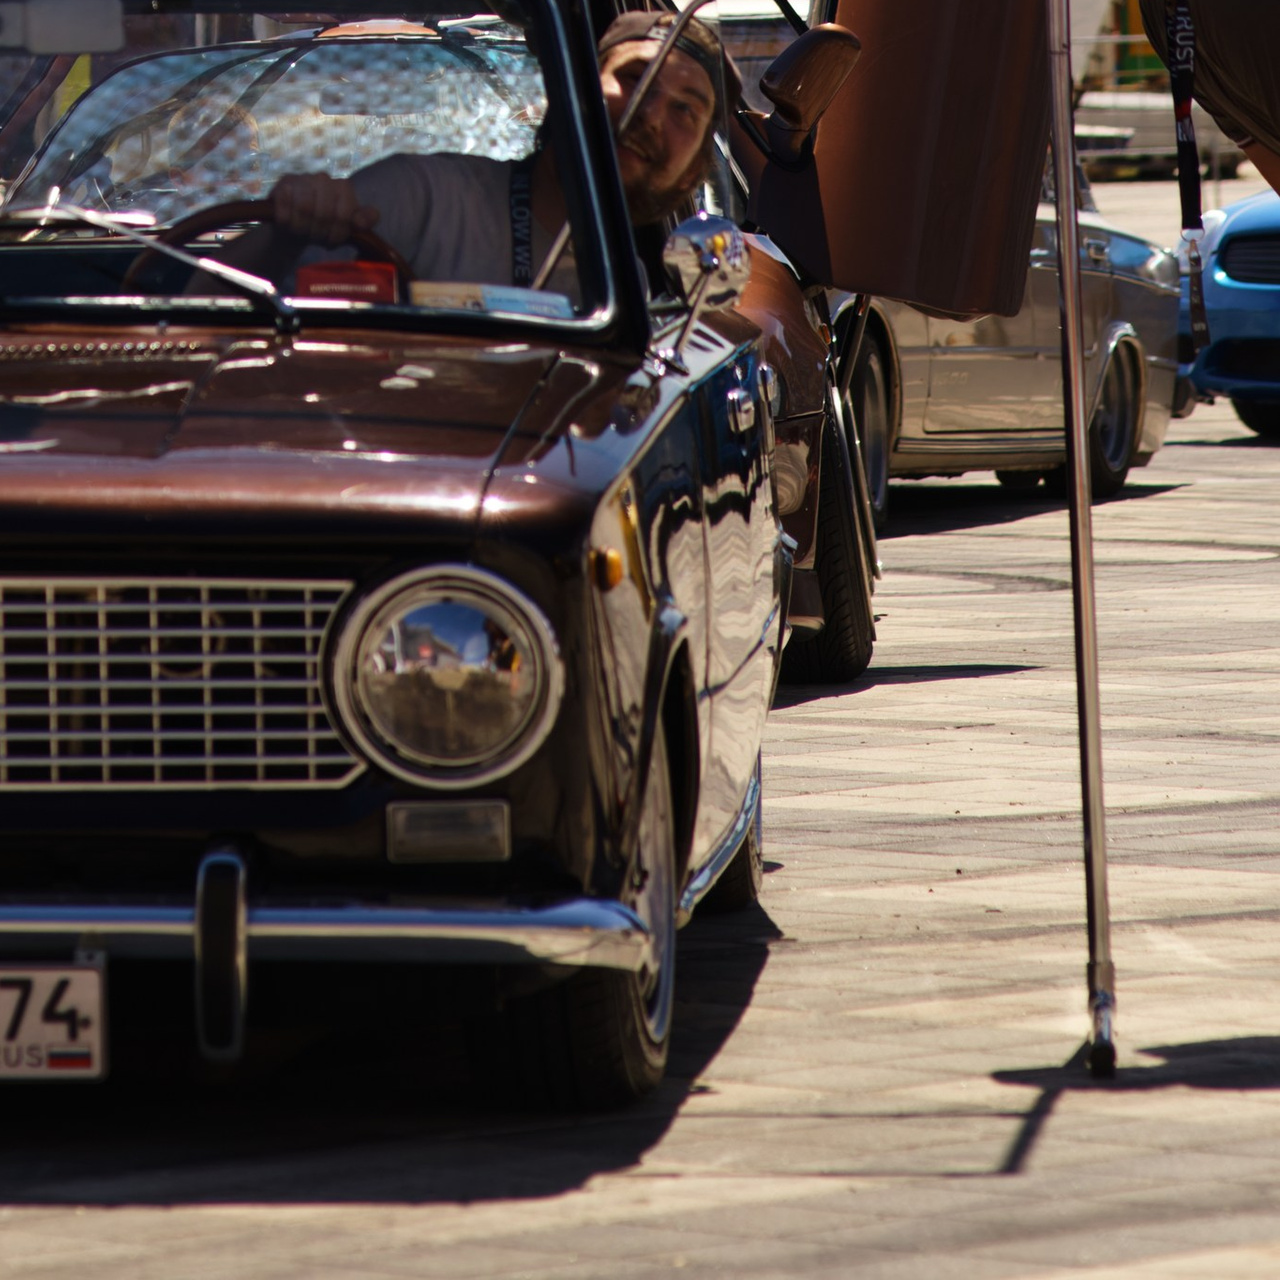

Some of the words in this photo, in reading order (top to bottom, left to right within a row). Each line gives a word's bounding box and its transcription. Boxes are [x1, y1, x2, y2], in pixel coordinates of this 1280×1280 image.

[1176, 6, 1195, 73] TRUST
[510, 193, 531, 242] LOW
[513, 244, 531, 279] WE
